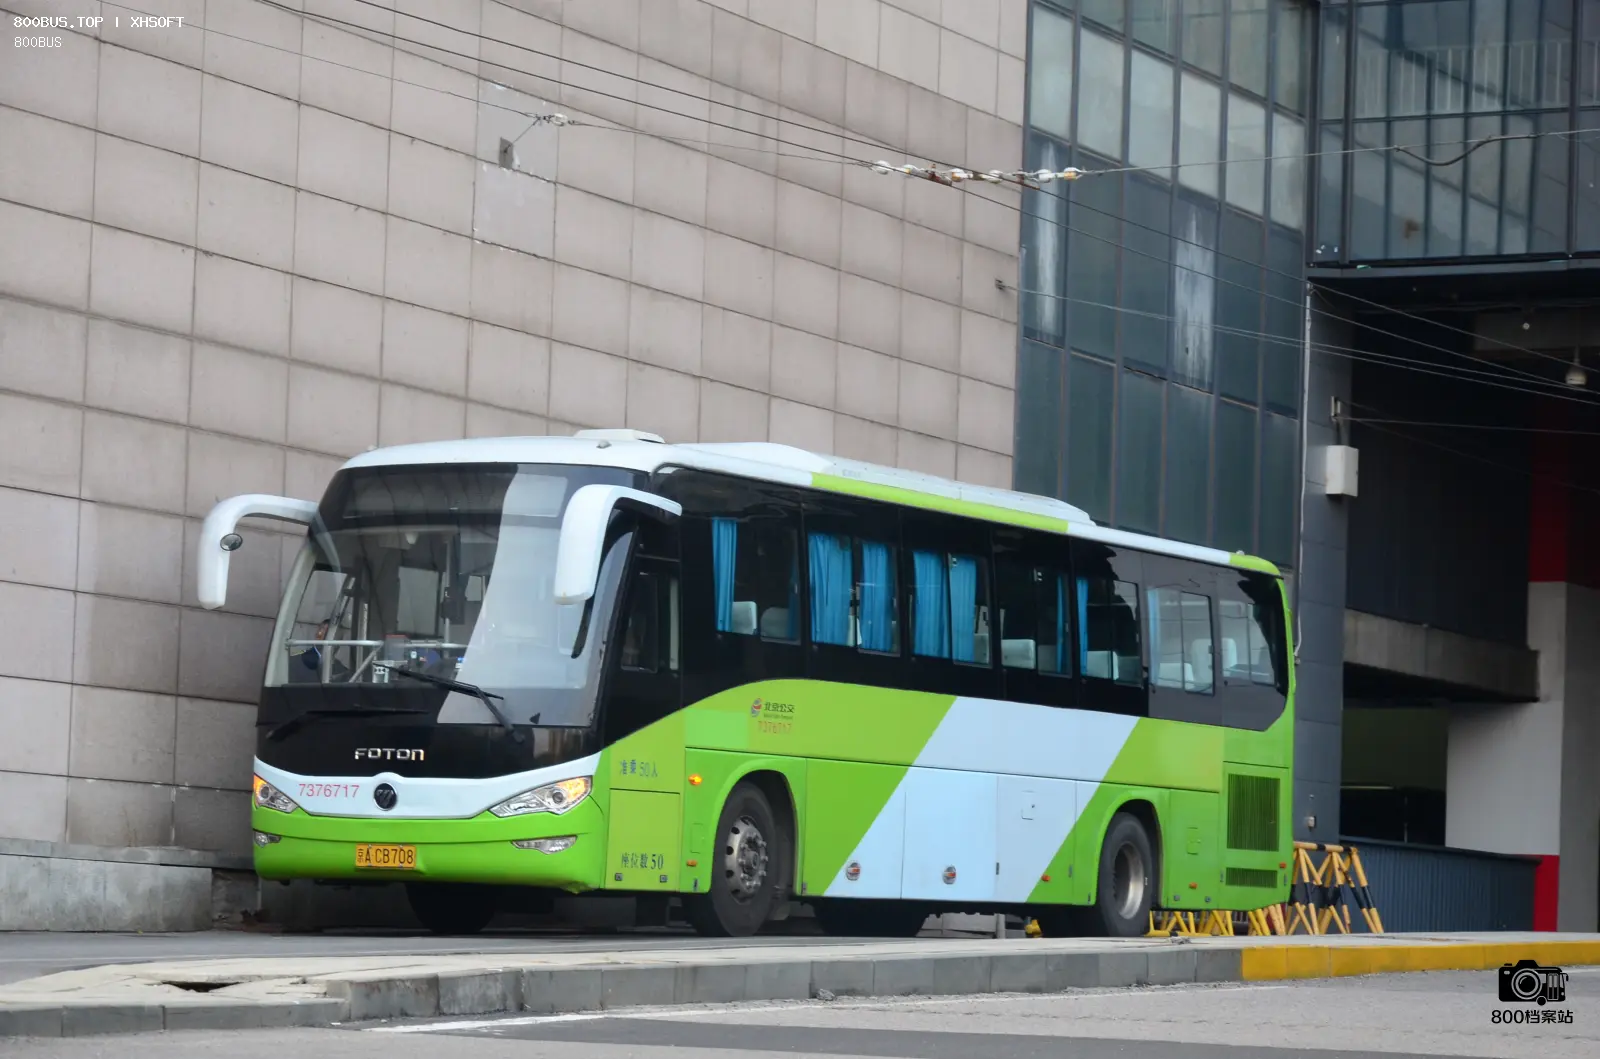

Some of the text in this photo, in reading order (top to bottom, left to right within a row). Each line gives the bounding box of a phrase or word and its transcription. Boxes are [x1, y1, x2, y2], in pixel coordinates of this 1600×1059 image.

[764, 701, 795, 714] 北京公交
[354, 747, 425, 761] FOTON
[298, 783, 360, 798] 7376717
